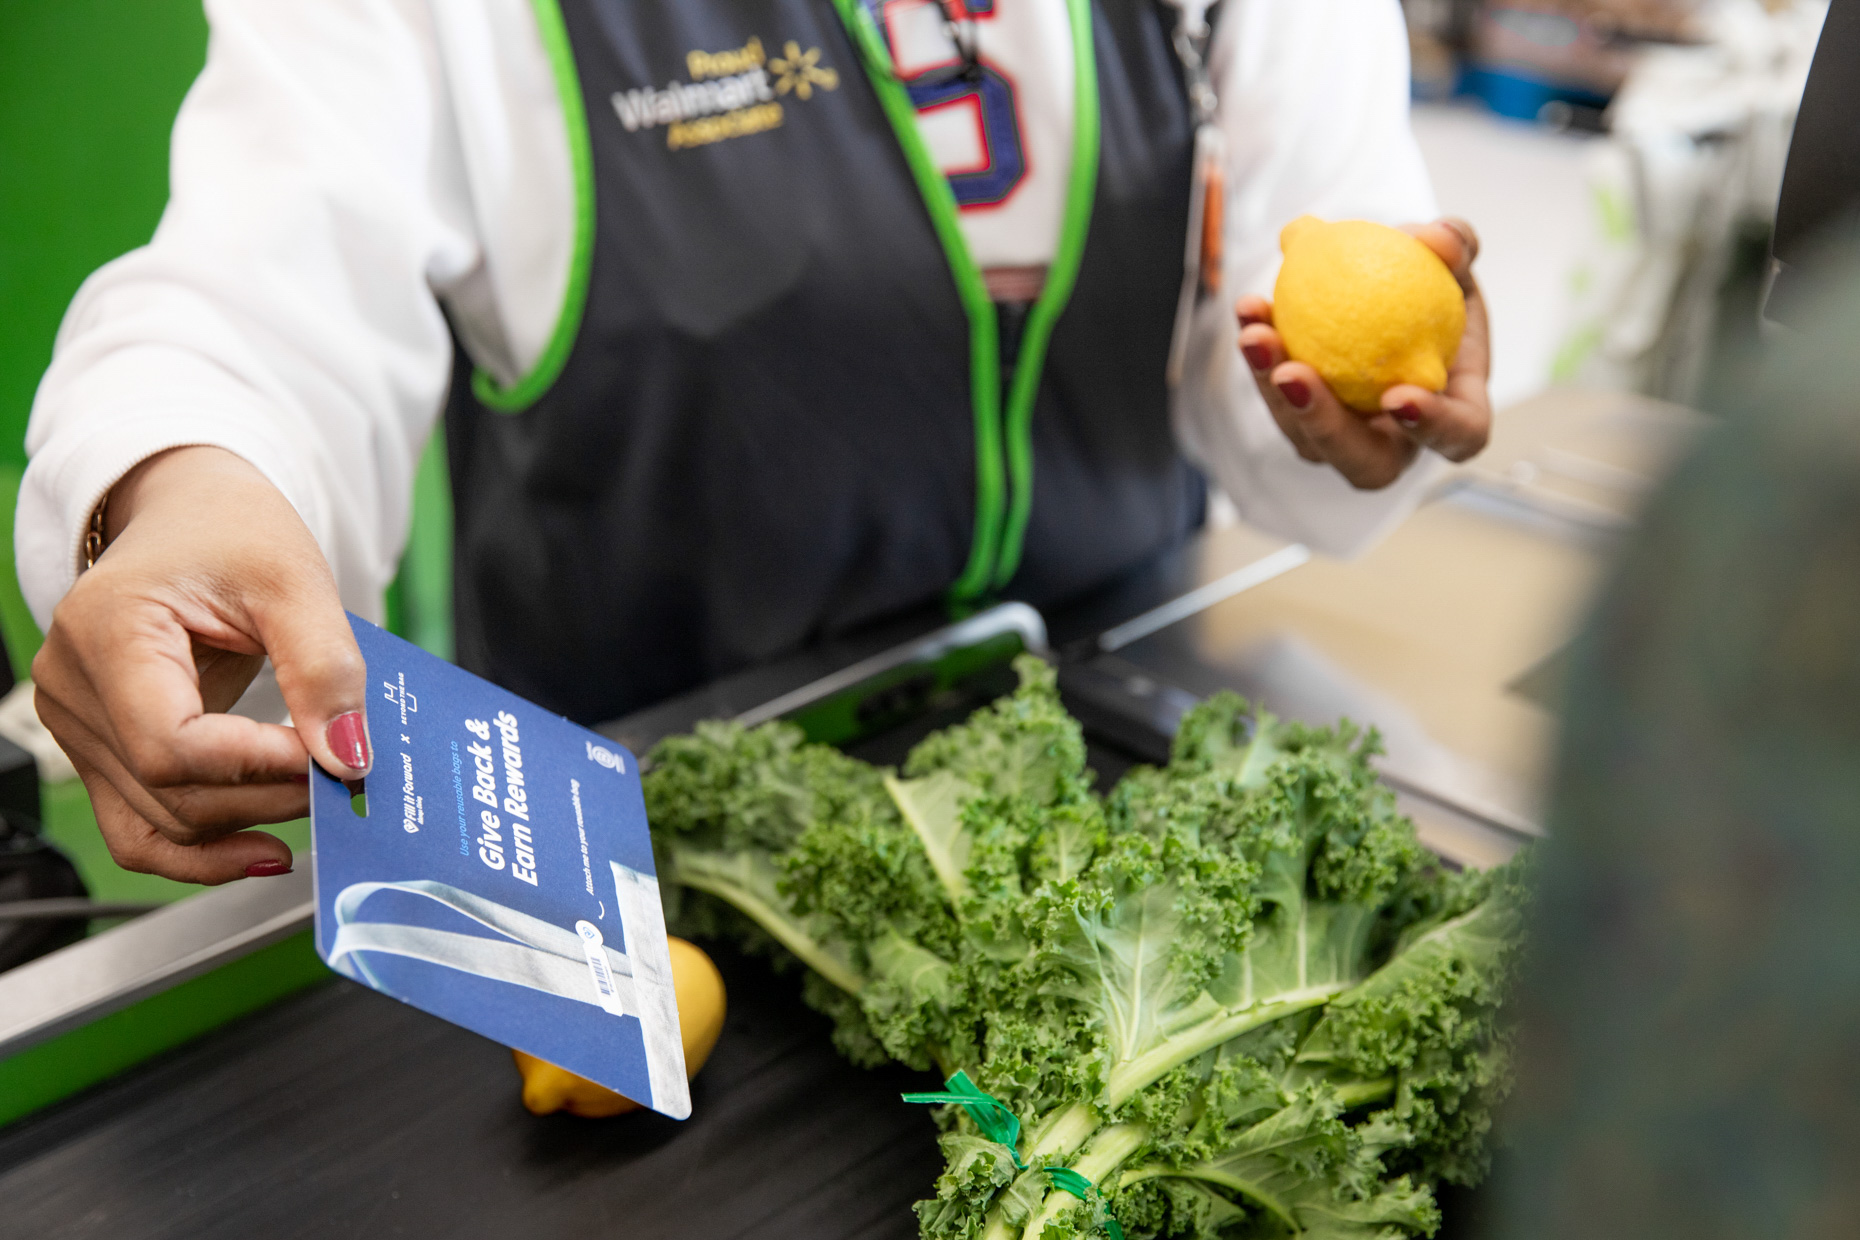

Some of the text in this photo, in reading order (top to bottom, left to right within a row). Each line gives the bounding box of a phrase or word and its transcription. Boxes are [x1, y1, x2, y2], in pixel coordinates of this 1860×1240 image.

[400, 752, 414, 796] Forward
[570, 778, 580, 796] bag
[450, 740, 470, 856] Use your reusable bags to
[465, 718, 505, 870] Give Back &
[493, 710, 538, 886] Earn Rewards
[578, 826, 588, 846] your
[581, 844, 588, 855] to
[582, 854, 590, 868] me
[583, 867, 594, 896] Attach
